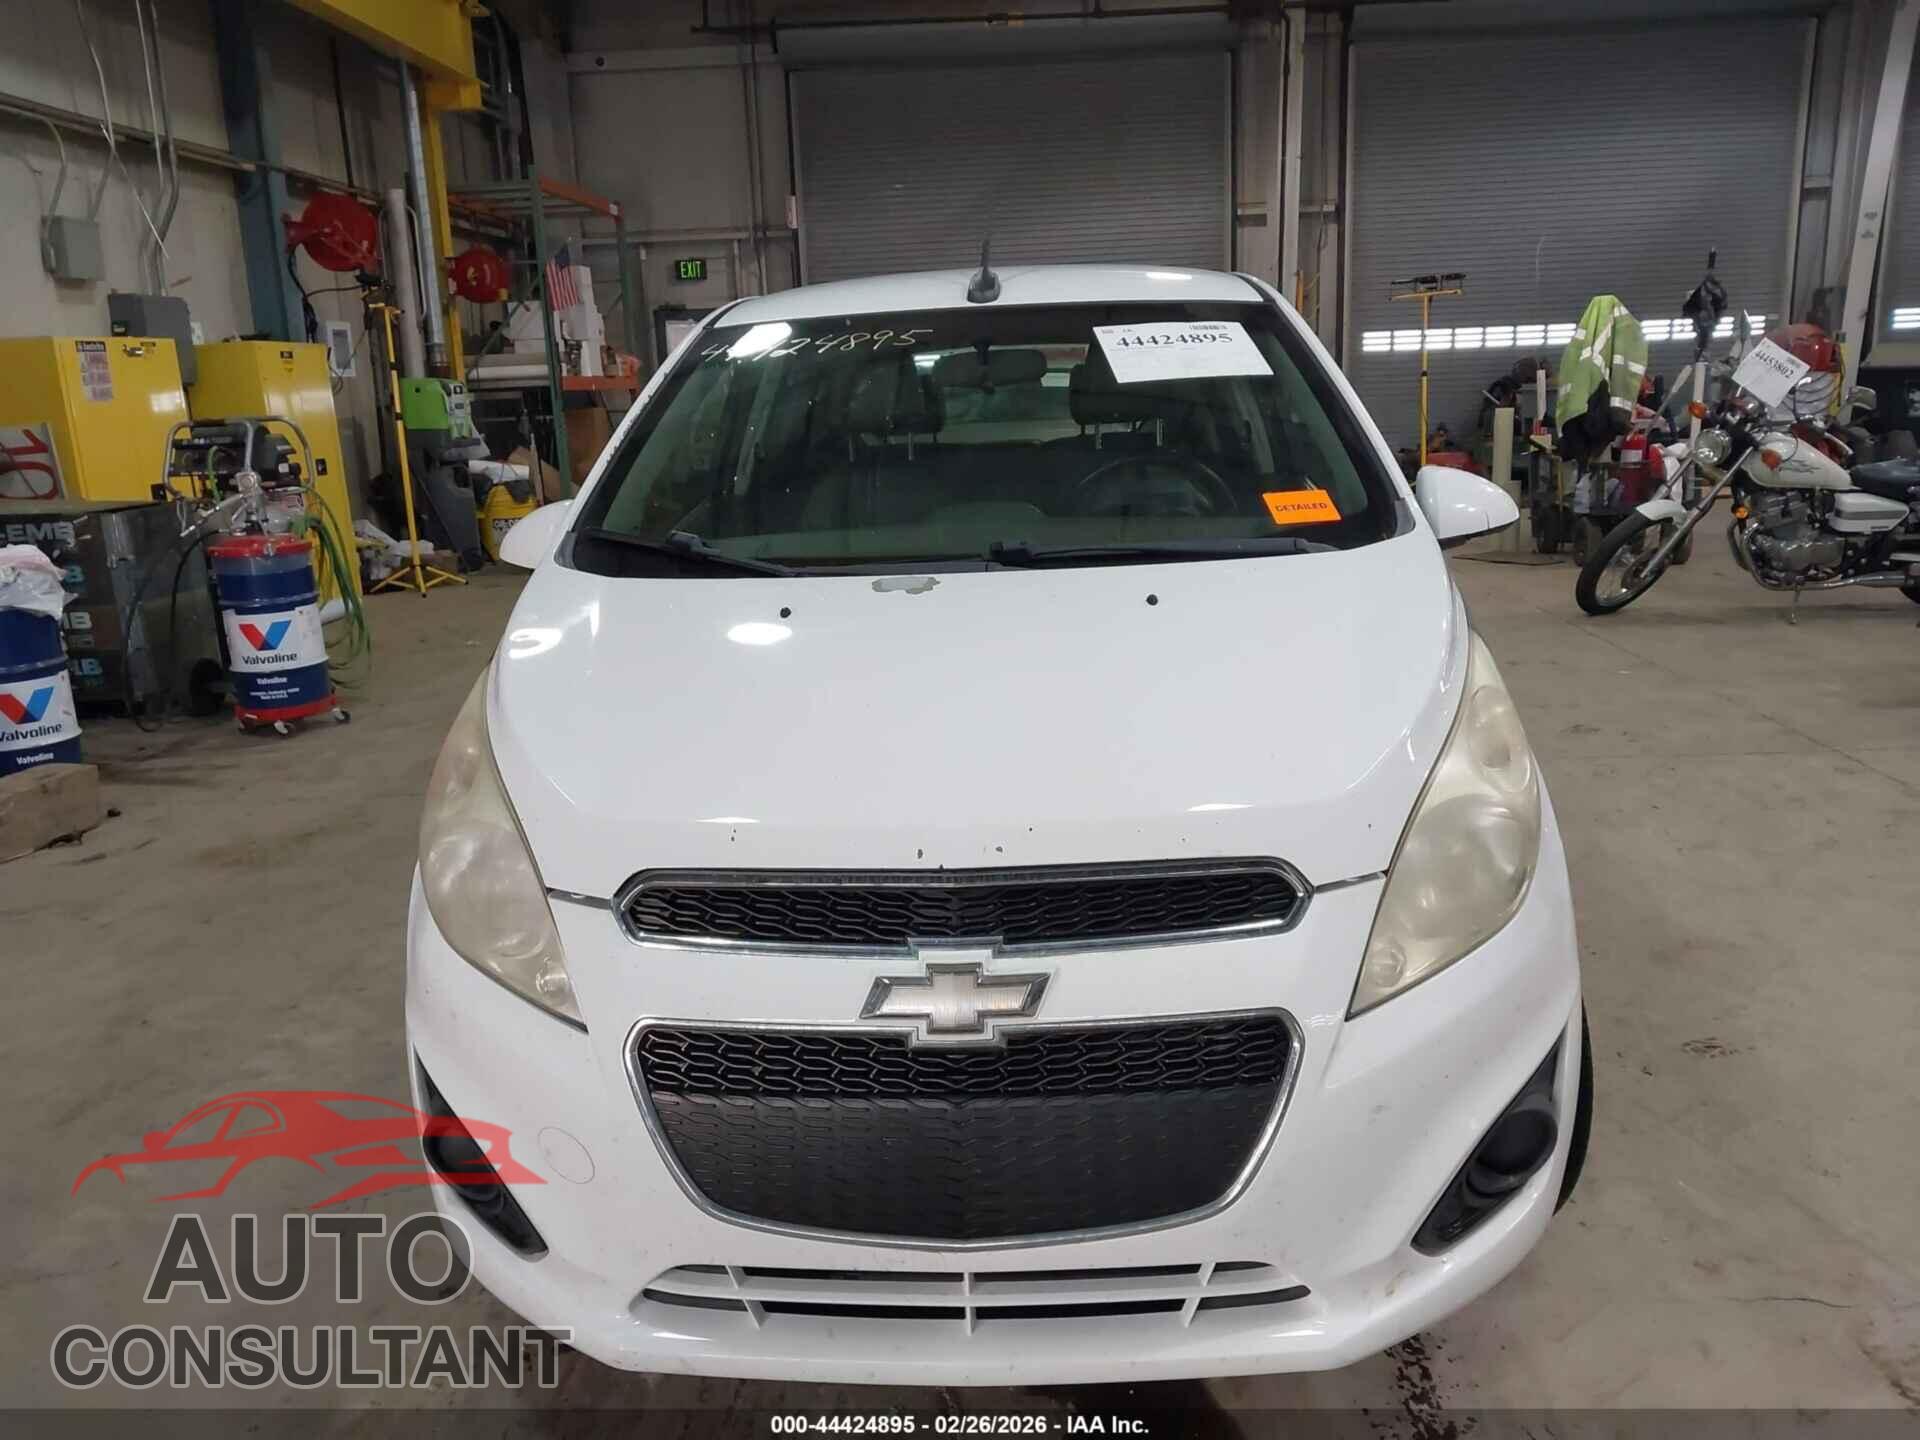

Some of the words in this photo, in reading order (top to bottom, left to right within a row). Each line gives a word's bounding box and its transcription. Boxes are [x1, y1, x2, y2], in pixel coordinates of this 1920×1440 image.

[681, 261, 701, 278] EXIT
[1116, 332, 1233, 347] 44424895
[1275, 502, 1328, 513] DETAILED
[241, 652, 298, 665] Valvoline
